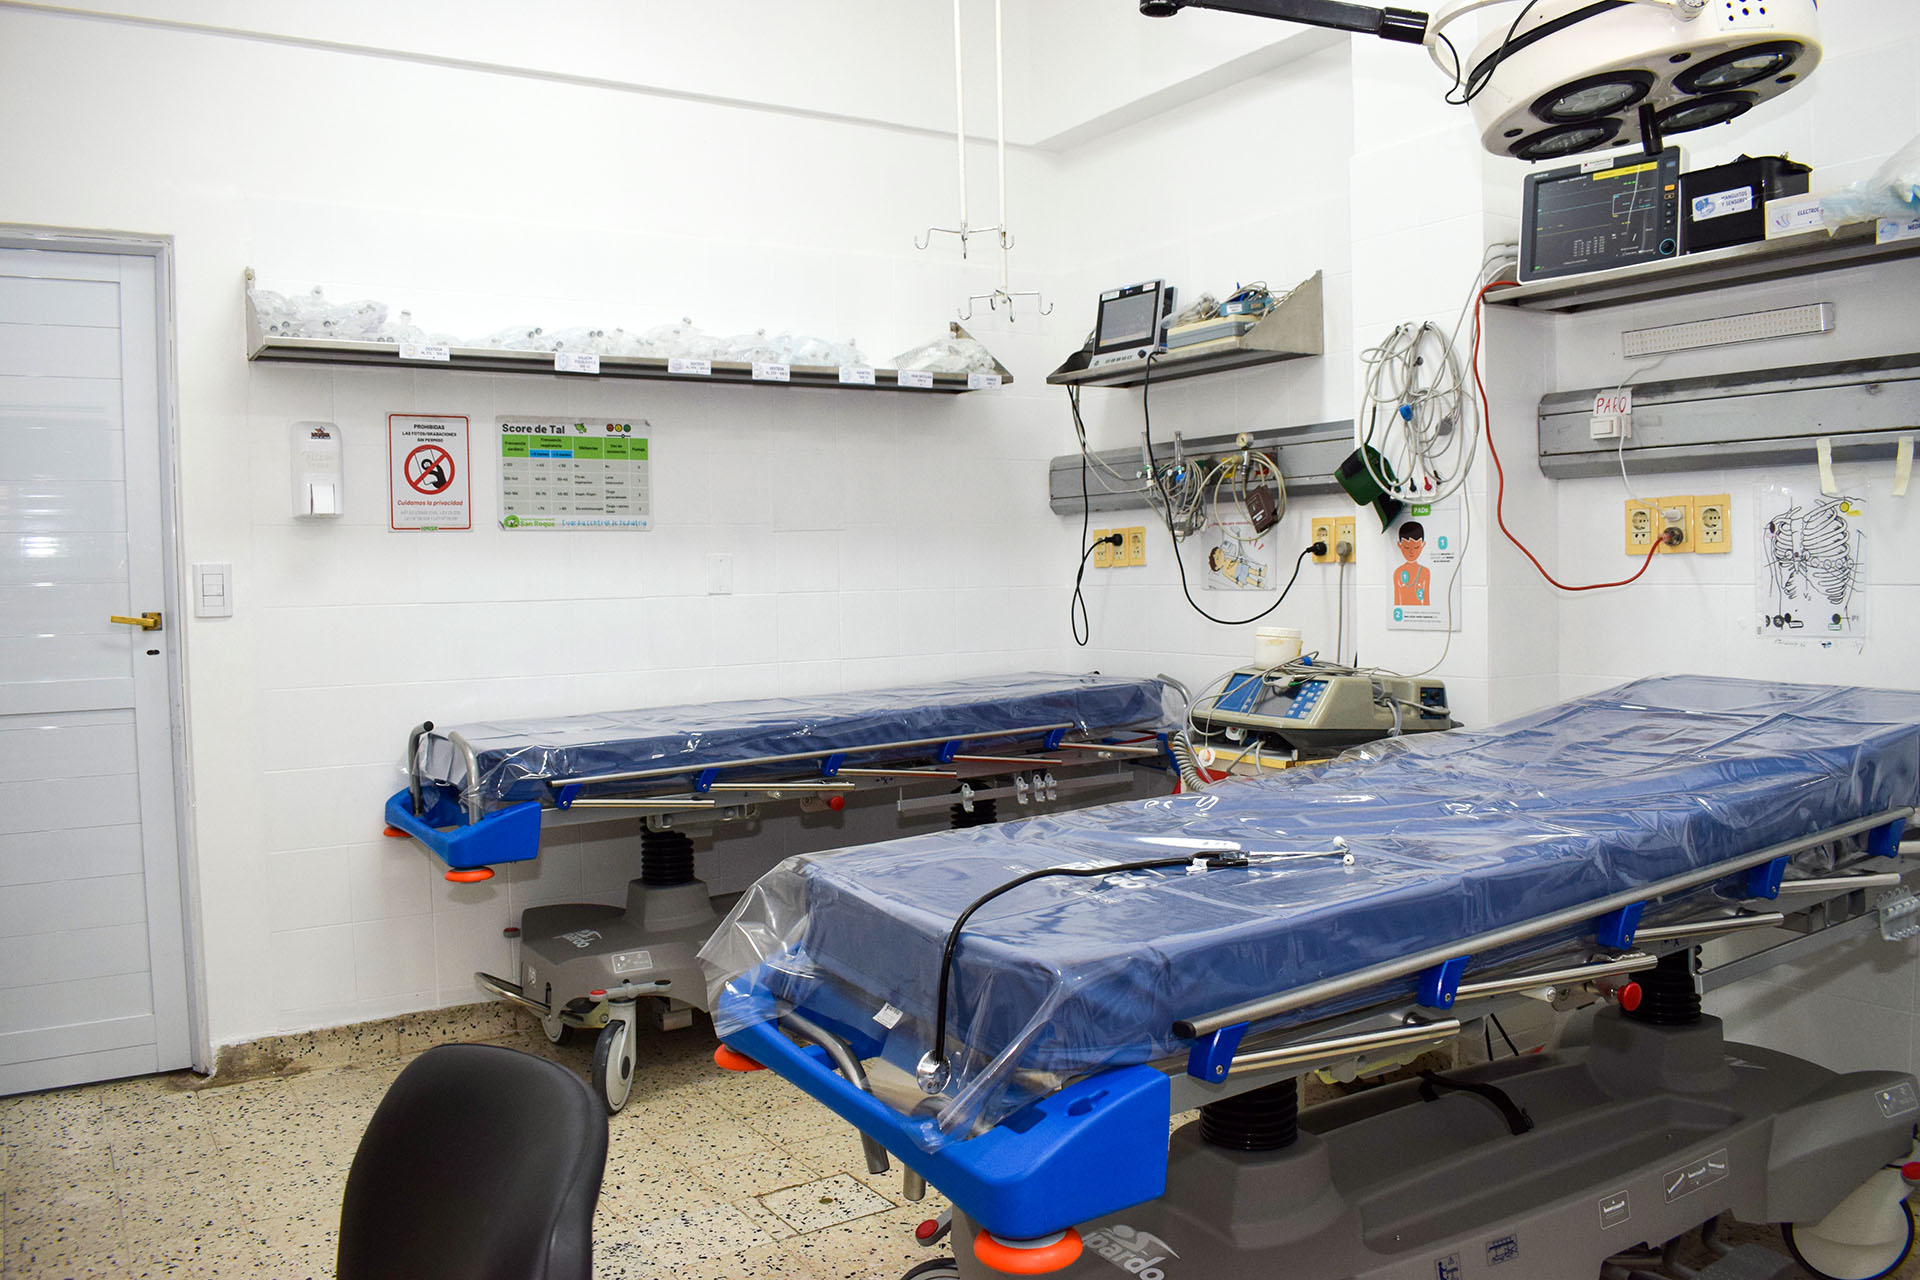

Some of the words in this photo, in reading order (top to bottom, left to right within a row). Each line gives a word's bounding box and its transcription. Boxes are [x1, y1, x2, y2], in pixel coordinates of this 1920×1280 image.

[502, 423, 533, 433] Score
[534, 424, 548, 434] de
[549, 424, 565, 434] Tal
[534, 519, 555, 527] Roque
